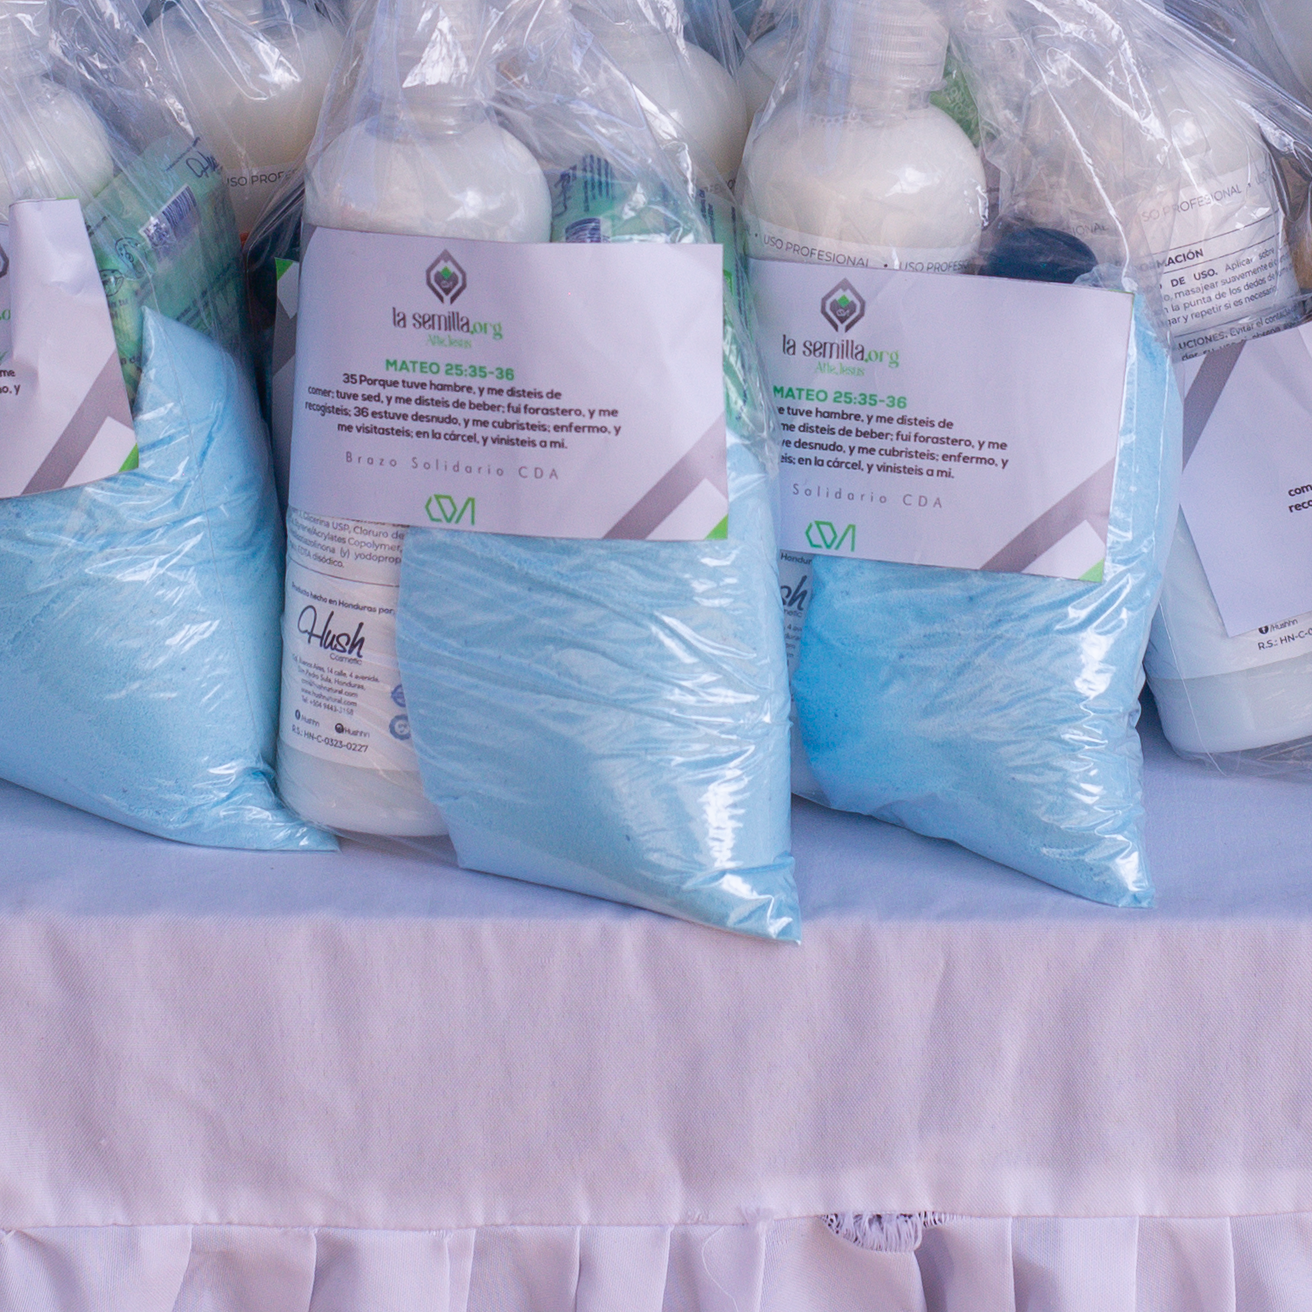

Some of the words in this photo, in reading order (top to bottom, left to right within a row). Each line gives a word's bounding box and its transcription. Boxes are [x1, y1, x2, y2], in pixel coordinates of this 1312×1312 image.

[760, 235, 784, 251] USO
[391, 306, 407, 328] la
[412, 311, 503, 340] semilla.org
[782, 334, 796, 356] la
[803, 340, 899, 368] semilla.org
[385, 359, 441, 375] MATEO
[444, 363, 514, 381] 25:35-36
[342, 373, 358, 385] 35
[359, 374, 399, 389] Porque
[401, 379, 427, 390] tuve
[429, 380, 475, 394] hambre,
[478, 386, 485, 397] y
[487, 387, 504, 396] me
[506, 387, 544, 399] disteis
[545, 389, 562, 400] de
[773, 385, 828, 402] MATEO
[833, 391, 907, 409] 25:35-36
[307, 386, 334, 399] comer;
[336, 390, 359, 401] tuve
[361, 392, 384, 404] sed,
[385, 396, 393, 406] y
[394, 396, 413, 405] me
[414, 396, 450, 408] disteis
[451, 399, 466, 409] de
[468, 400, 504, 413] beber;
[507, 403, 521, 414] fui
[523, 404, 585, 417] forastero,
[588, 409, 596, 419] y
[599, 409, 619, 418] me
[305, 401, 351, 417] recogisteis;
[354, 406, 369, 418] 36
[371, 410, 409, 421] estuve
[411, 412, 461, 426] desnudo,
[463, 418, 470, 428] y
[472, 419, 490, 428] me
[491, 419, 550, 432] cubristeis;
[553, 422, 610, 434] enfermo,
[613, 426, 621, 436] y
[337, 423, 354, 433] me
[355, 424, 413, 438] visitasteis;
[415, 430, 430, 439] en
[431, 429, 442, 440] la
[443, 431, 479, 444] cárcel,
[481, 436, 489, 447] y
[491, 435, 537, 448] vinisteis
[539, 440, 547, 448] a
[345, 451, 397, 467] Brazo
[411, 456, 504, 476] Solidario
[518, 466, 558, 479] CDA
[792, 483, 887, 504] Solidario
[902, 494, 942, 508] CDA
[297, 605, 365, 660] Hush
[1257, 639, 1278, 650] R.S.:
